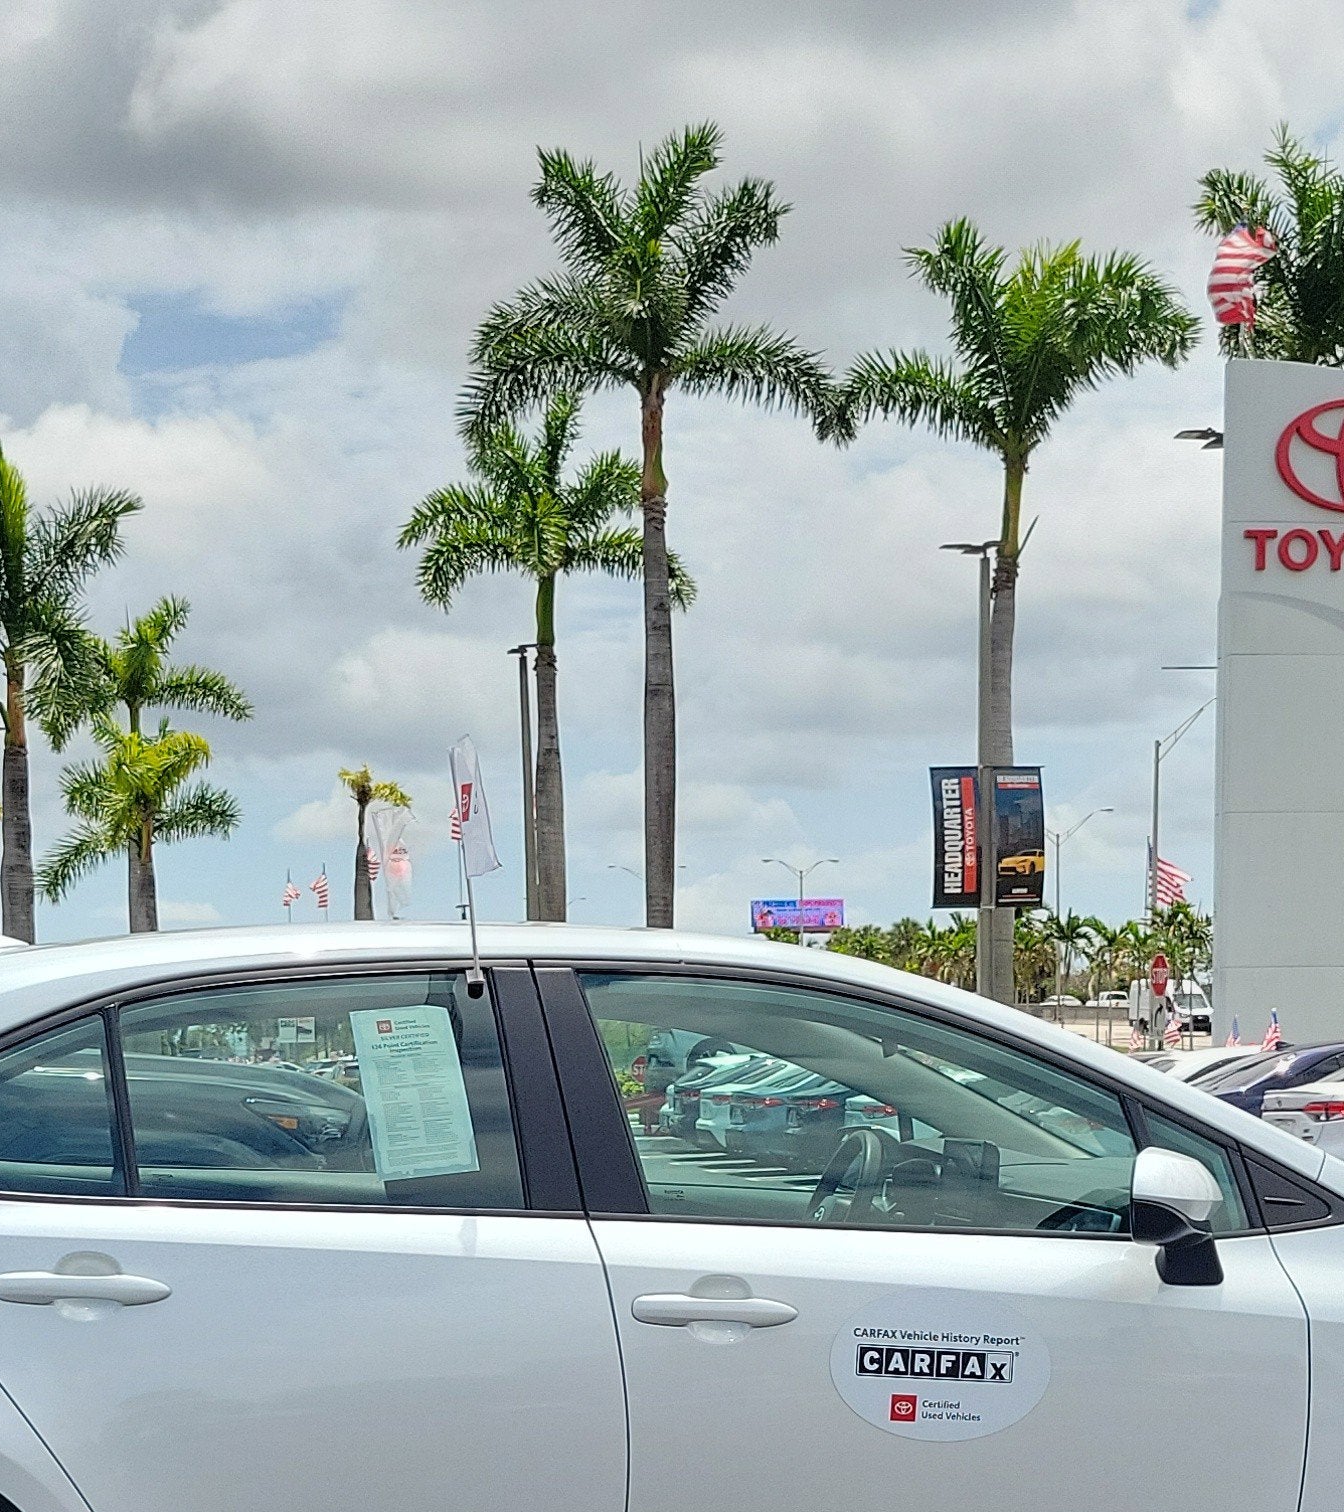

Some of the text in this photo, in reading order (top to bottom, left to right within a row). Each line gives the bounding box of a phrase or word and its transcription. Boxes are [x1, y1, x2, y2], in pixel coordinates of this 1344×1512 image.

[942, 779, 964, 893] HEADQUARTER
[964, 808, 975, 852] TOYOTA
[1152, 967, 1168, 985] STOP
[853, 1327, 898, 1340] CARFAX
[899, 1329, 940, 1342] Vehicle
[941, 1332, 981, 1346] History
[922, 1399, 961, 1410] Certified
[921, 1411, 982, 1422] Used Vehicles
